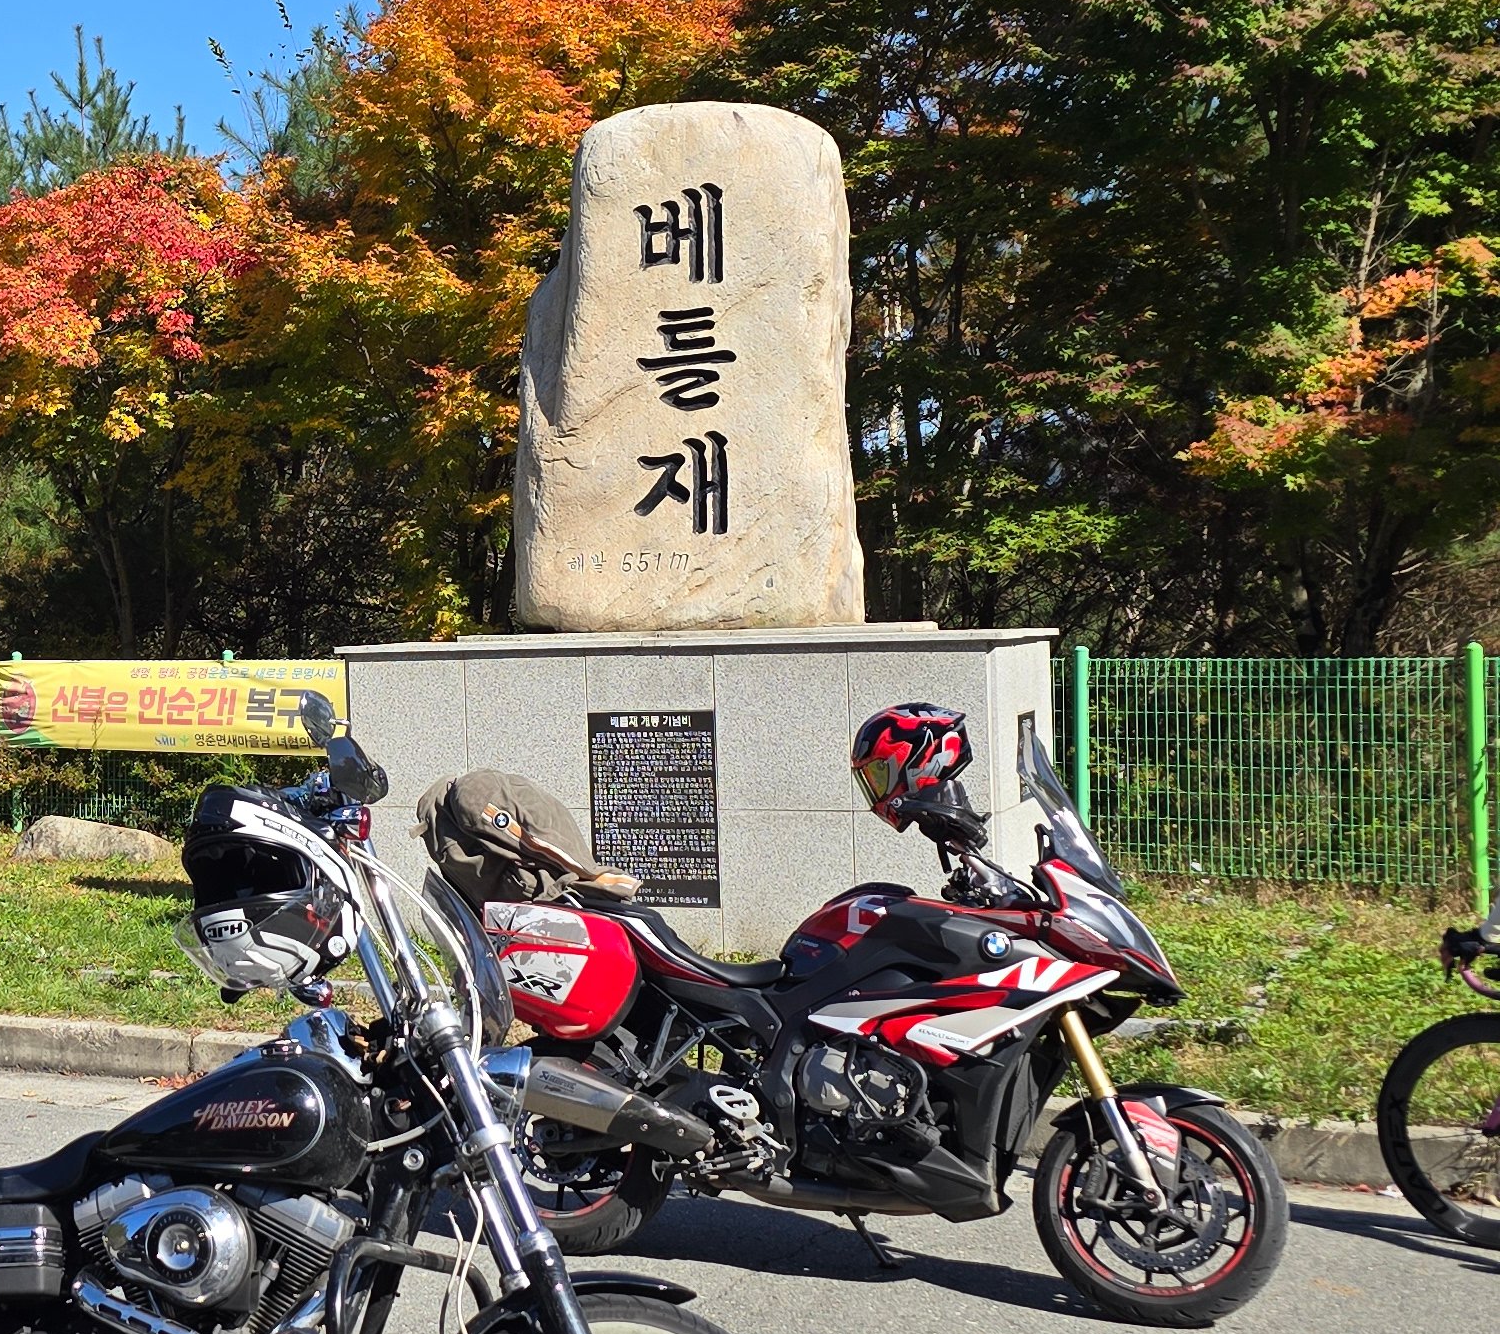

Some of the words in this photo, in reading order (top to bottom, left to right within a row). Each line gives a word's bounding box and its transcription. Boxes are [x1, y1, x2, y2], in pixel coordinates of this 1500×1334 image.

[633, 181, 738, 535] 베틀재
[566, 550, 607, 574] 해발
[254, 667, 288, 680] 새로운
[51, 685, 130, 724] 산불은
[138, 685, 238, 726] 한순간!
[662, 715, 692, 728] 기념비
[207, 921, 243, 939] HJC
[507, 966, 563, 1001] XR
[193, 1098, 277, 1128] HARLEY-
[210, 1111, 296, 1131] DAVIDSON
